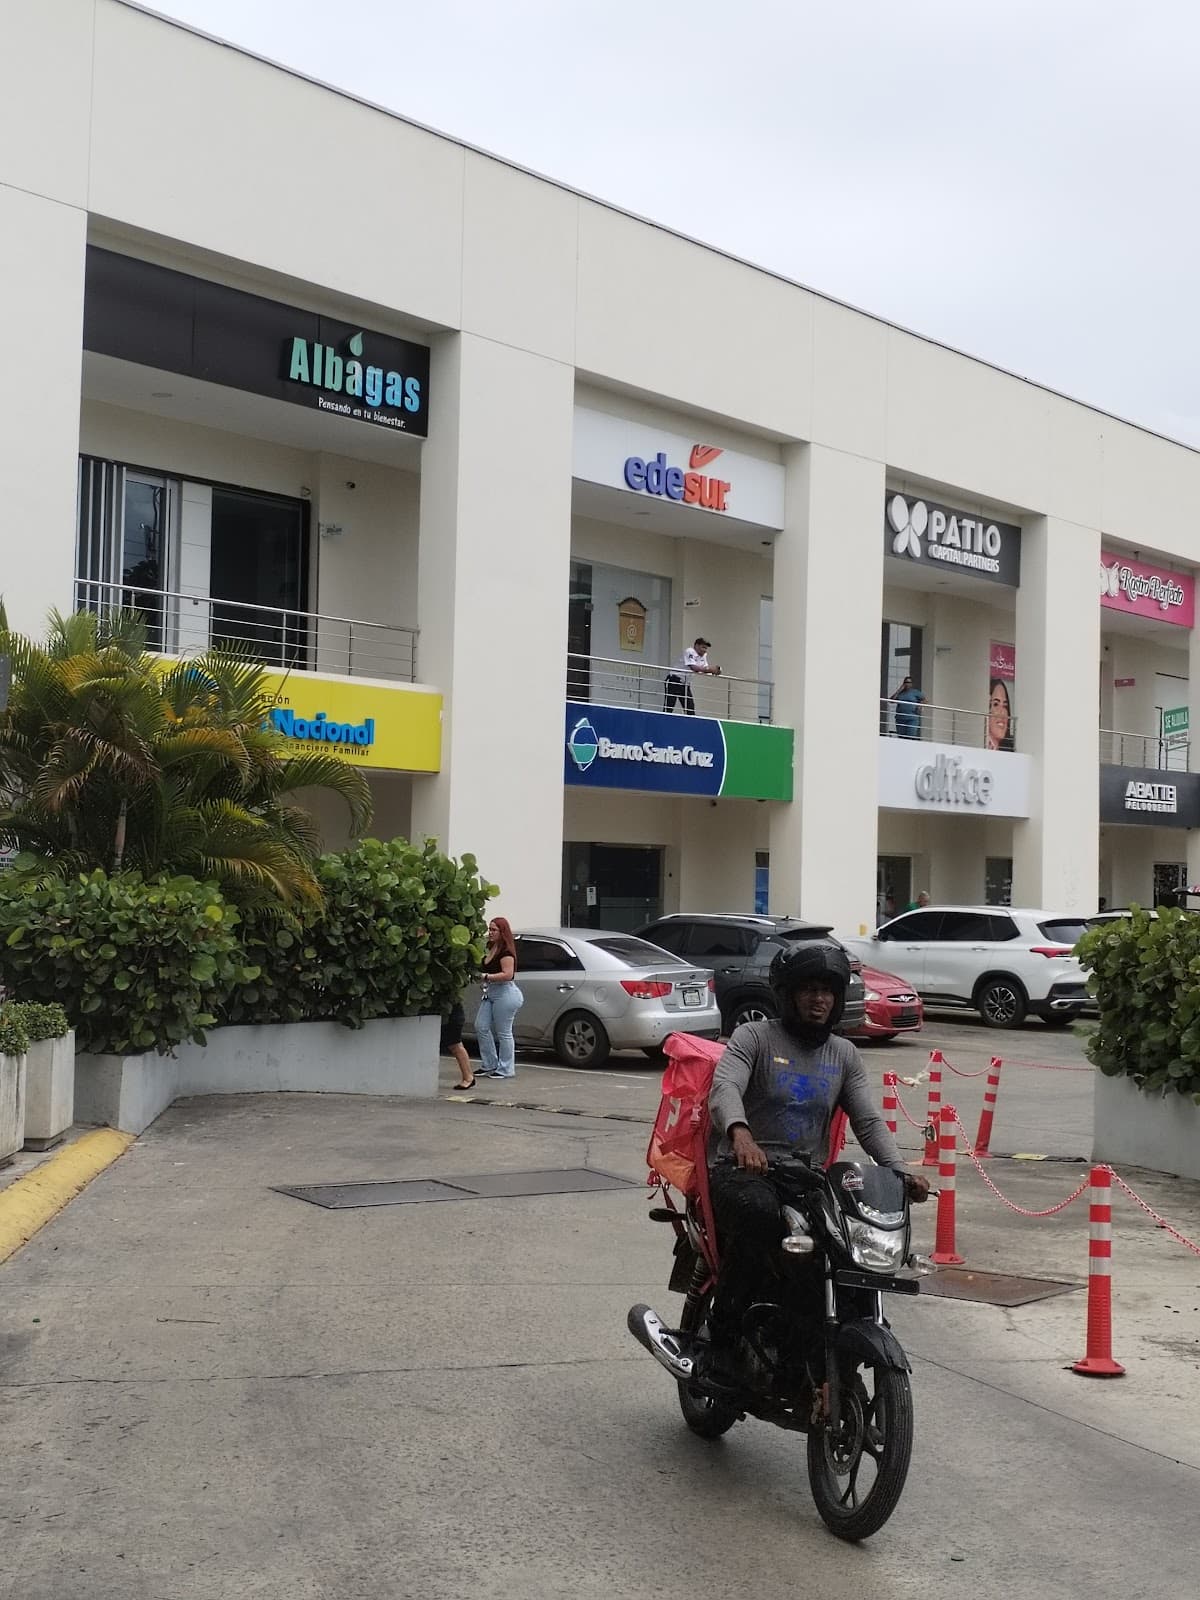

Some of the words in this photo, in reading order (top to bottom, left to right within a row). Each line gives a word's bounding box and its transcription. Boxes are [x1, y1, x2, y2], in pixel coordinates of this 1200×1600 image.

[318, 396, 351, 415] Pensando
[352, 408, 362, 417] en
[363, 409, 372, 419] tu
[624, 452, 731, 511] edesur
[927, 510, 1001, 557] PATIO
[928, 544, 963, 566] CAPITAL
[963, 551, 1000, 573] PARTNERS
[270, 708, 375, 746] Nacional
[333, 745, 369, 756] Familiar
[599, 737, 643, 761] Banco
[643, 741, 683, 765] Santa
[683, 745, 714, 767] Cruz
